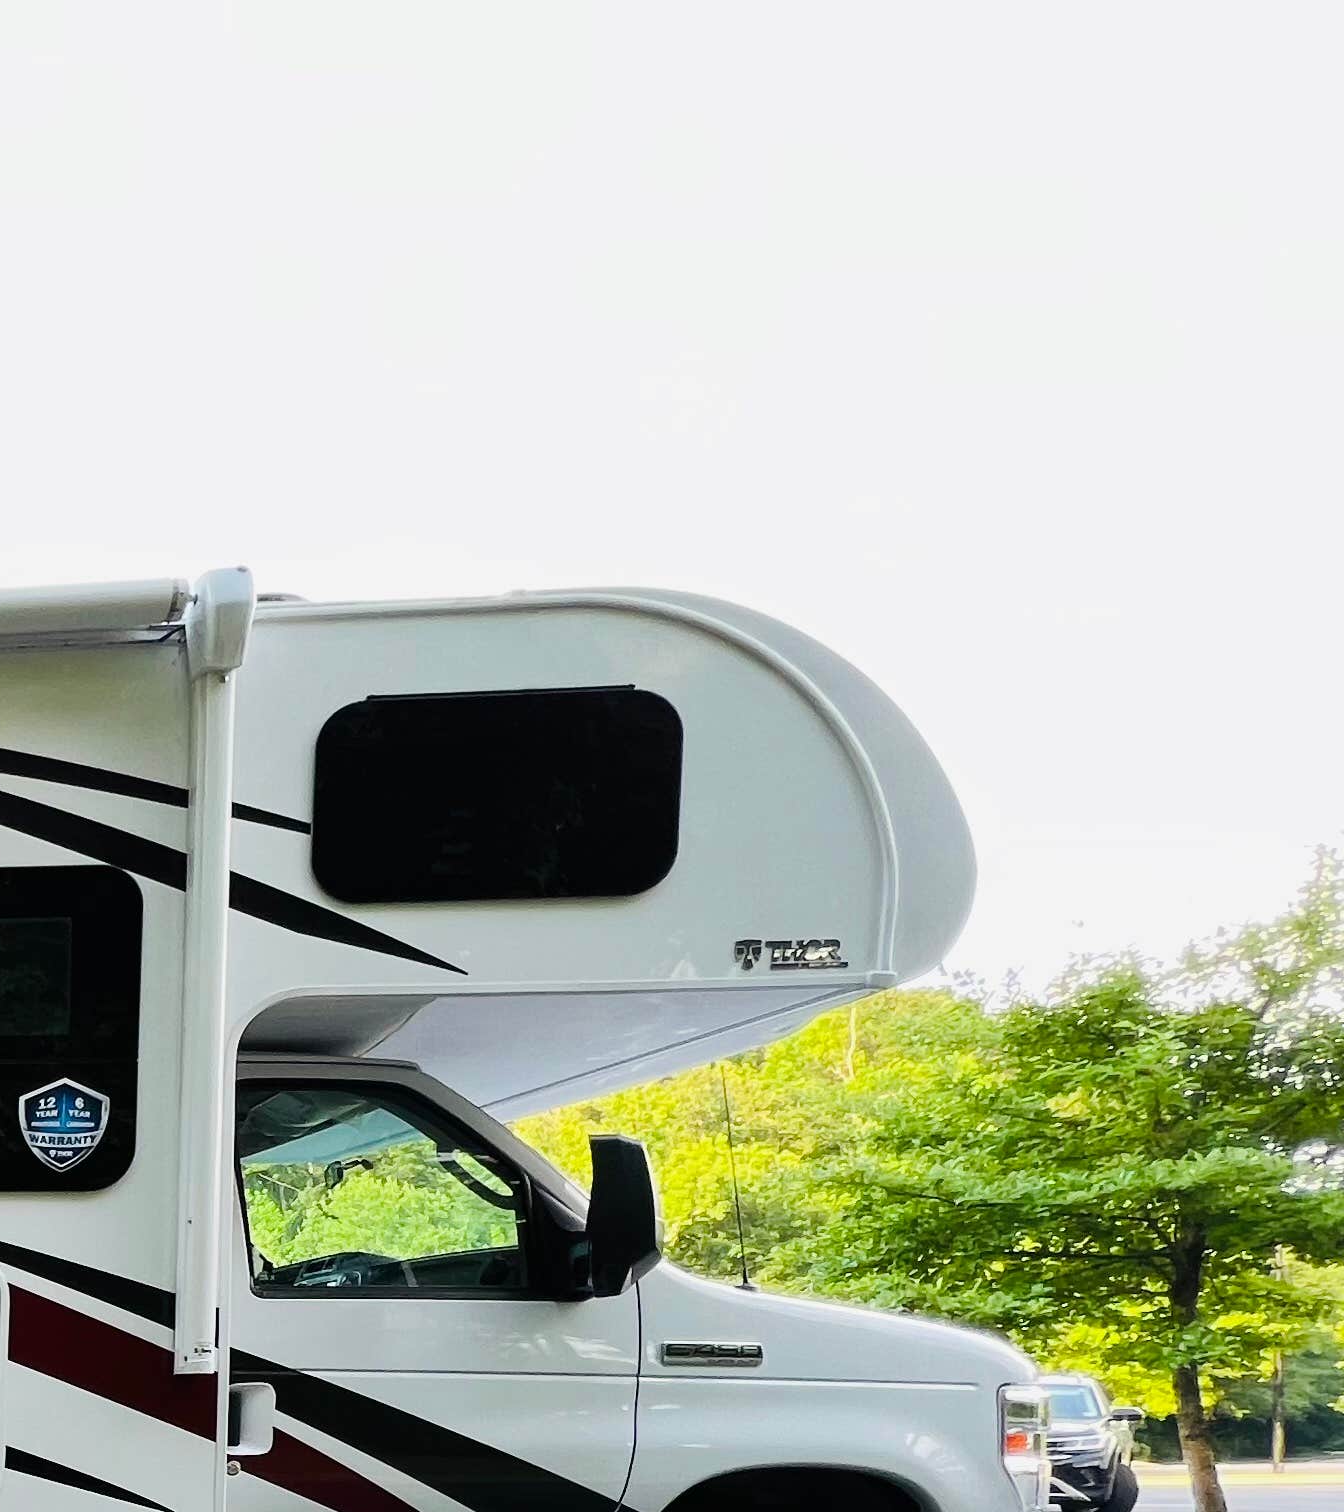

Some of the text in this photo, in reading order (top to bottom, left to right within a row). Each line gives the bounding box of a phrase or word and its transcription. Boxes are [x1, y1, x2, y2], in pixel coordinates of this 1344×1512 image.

[38, 1096, 57, 1110] 12
[75, 1097, 85, 1109] 6
[36, 1110, 58, 1118] YEAR
[68, 1110, 91, 1118] YEAR
[29, 1134, 98, 1146] WARRANTY
